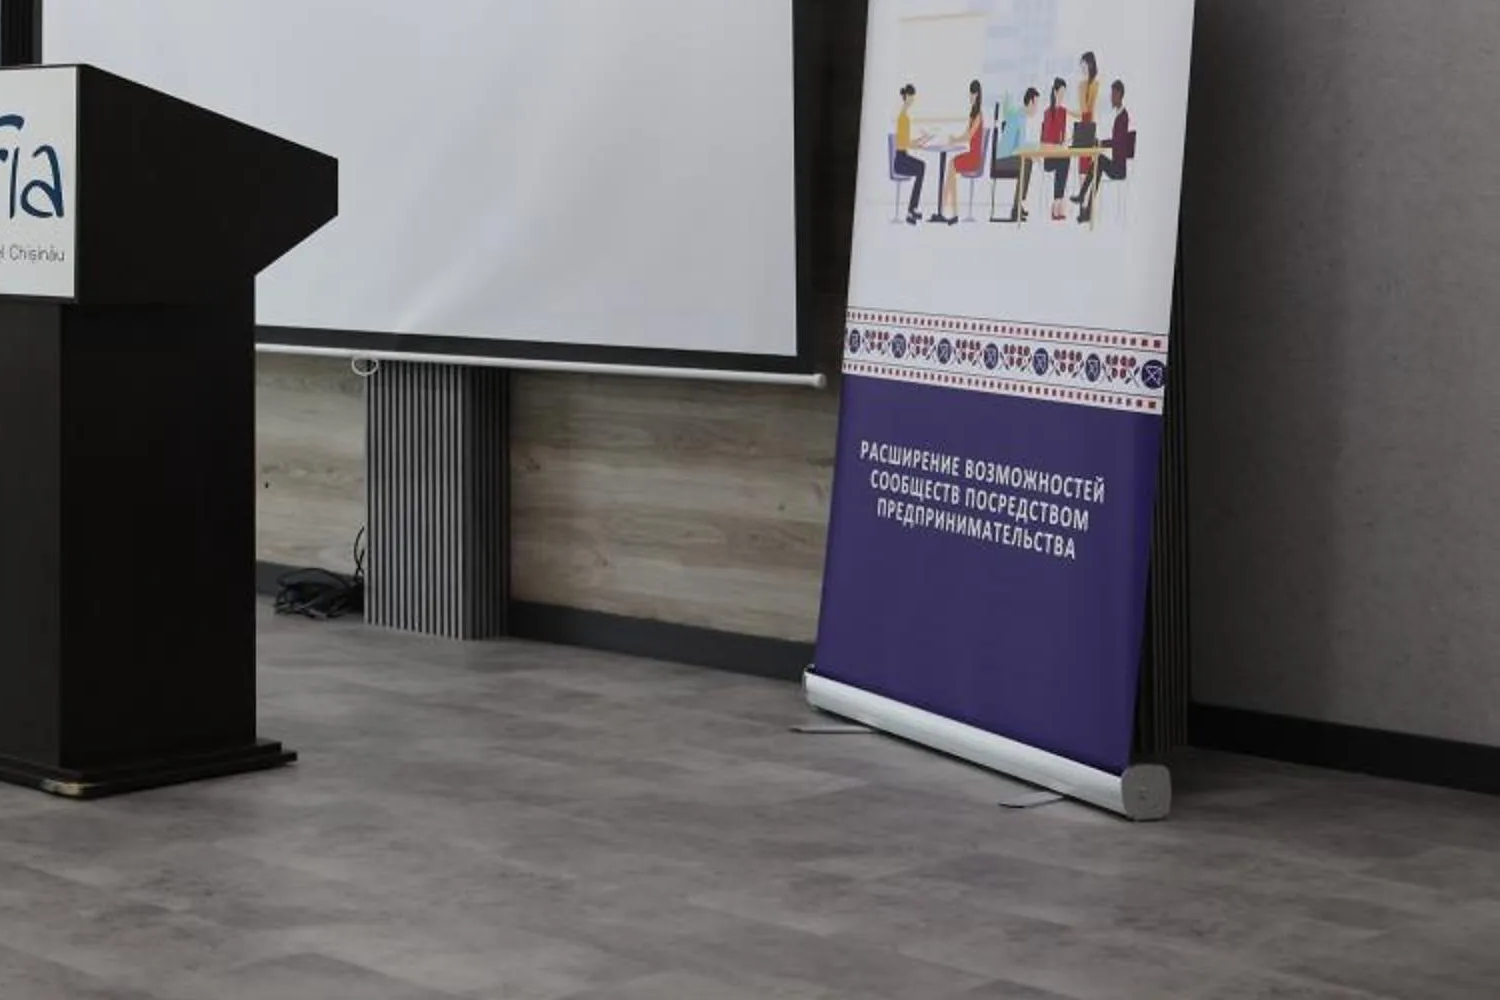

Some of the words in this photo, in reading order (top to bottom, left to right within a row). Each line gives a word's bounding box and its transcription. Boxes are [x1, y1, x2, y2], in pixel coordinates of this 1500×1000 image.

[860, 440, 960, 477] РАСШИРЕНИЕ
[965, 459, 1105, 504] ВОЗМОЖНОСТЕЙ
[870, 469, 960, 505] СООБЩЕСТВ
[965, 487, 1089, 532] ПОСРЕДСТВОМ
[877, 497, 1076, 560] ПРЕДПРИНИМАТЕЛЬСТВА
